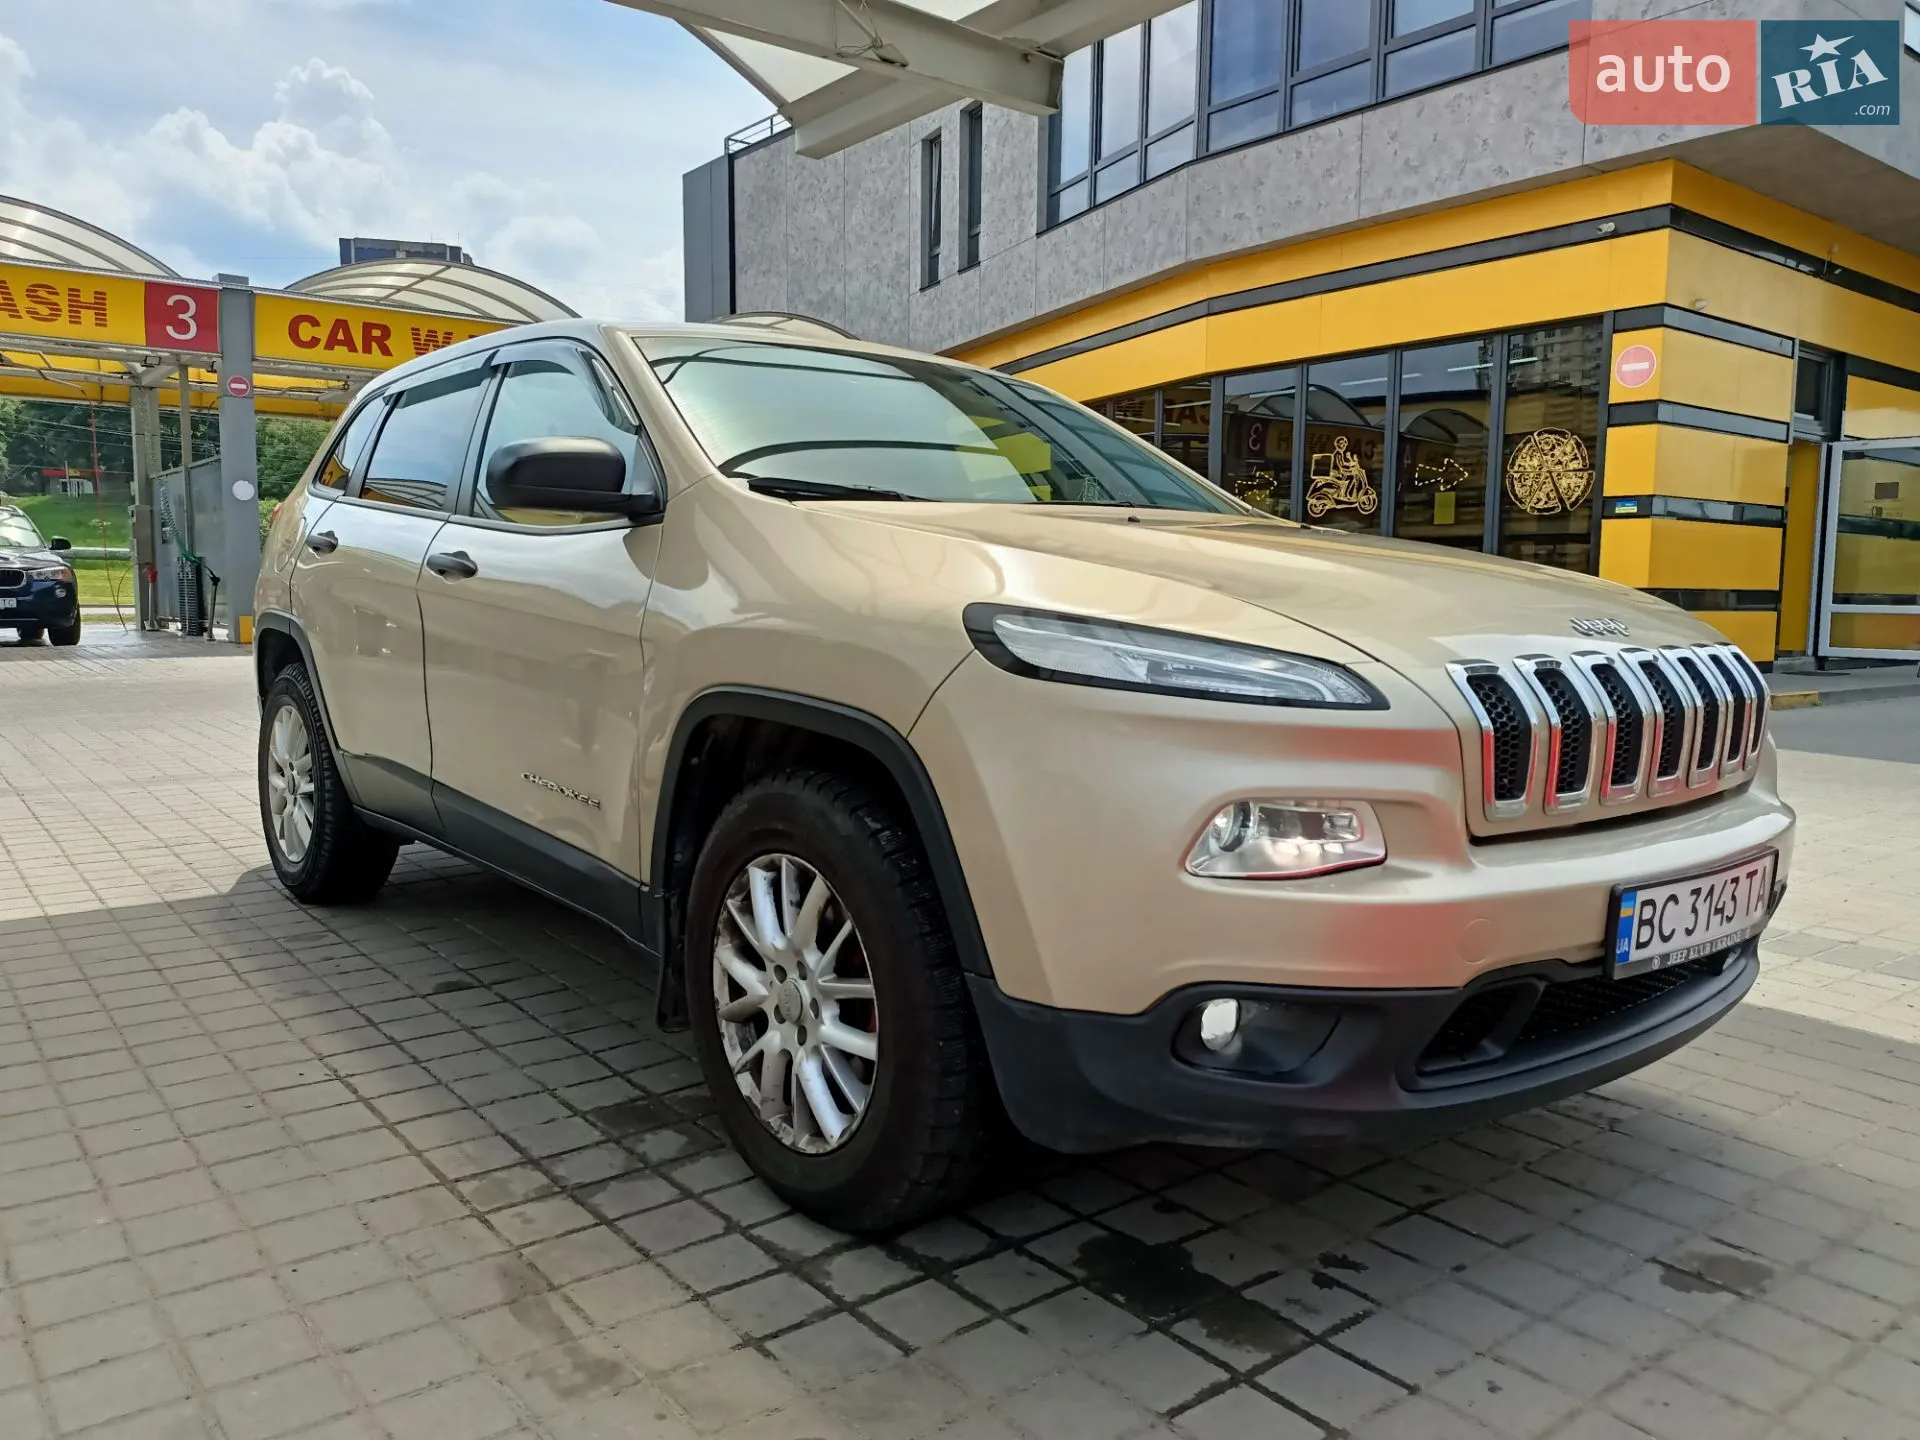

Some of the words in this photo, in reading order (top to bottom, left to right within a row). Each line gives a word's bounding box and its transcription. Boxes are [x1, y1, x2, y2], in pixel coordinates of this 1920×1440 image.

[165, 294, 198, 340] 3
[288, 314, 394, 357] CAR
[1635, 892, 1680, 950] BC
[1684, 876, 1739, 938] 3143
[1745, 865, 1768, 917] TA
[1616, 937, 1629, 955] UA
